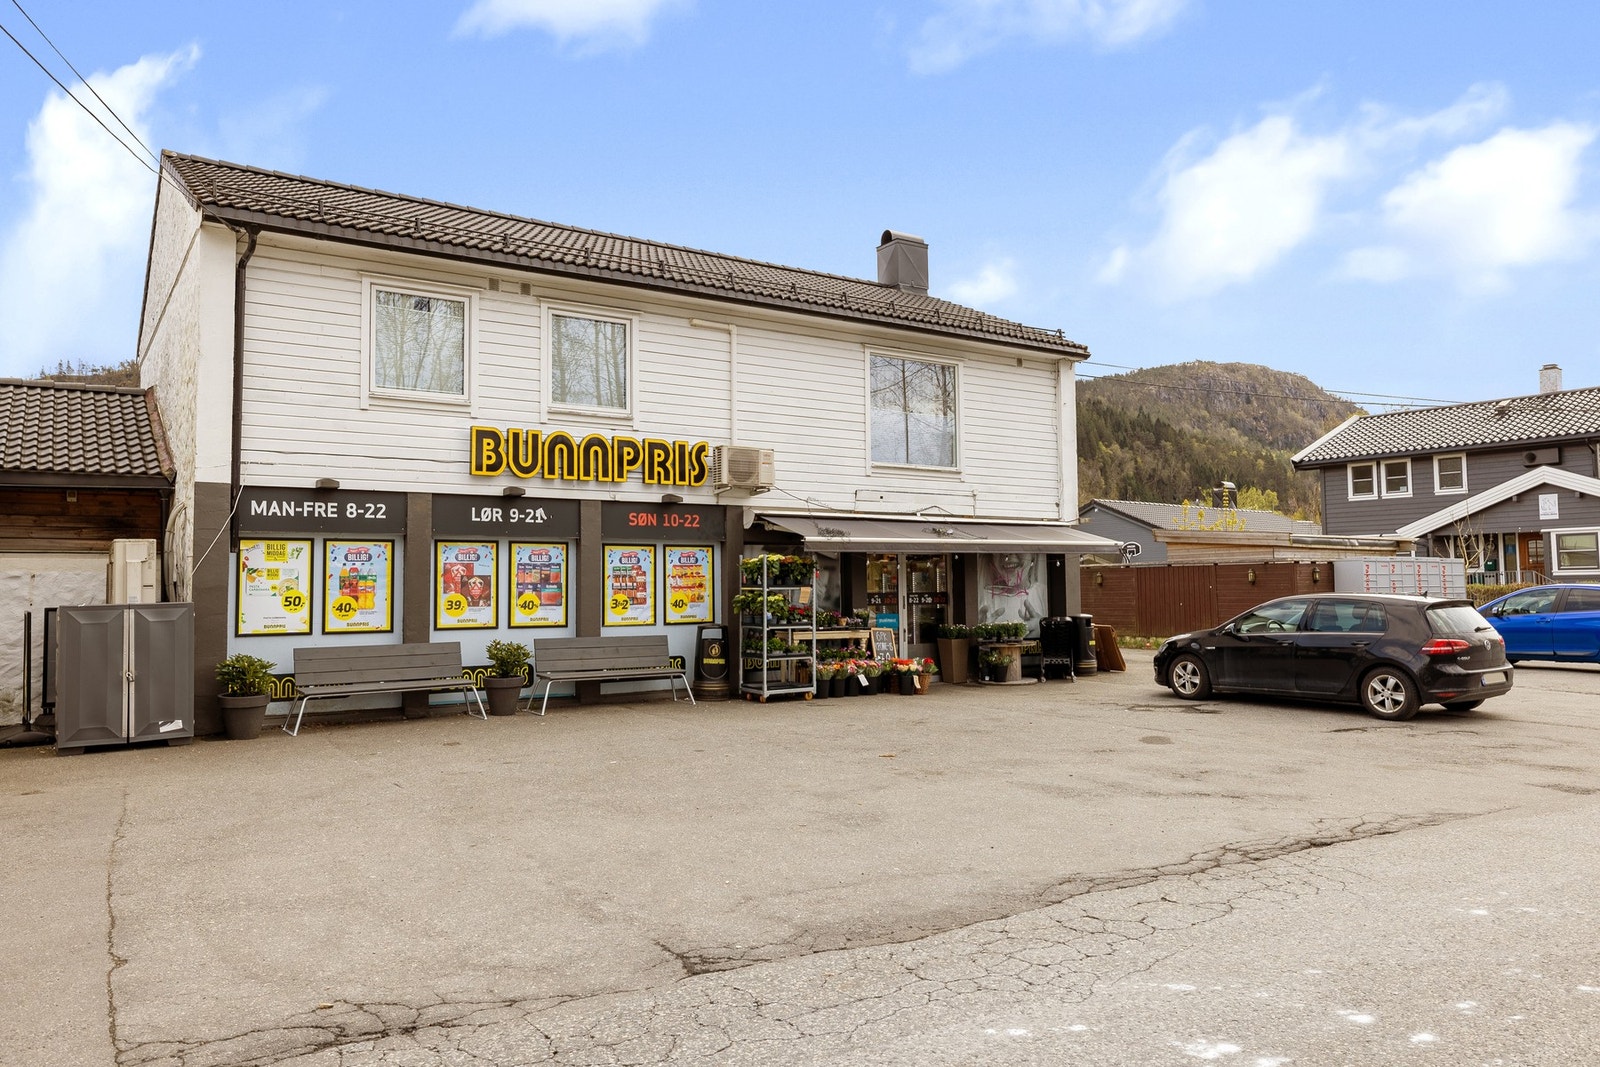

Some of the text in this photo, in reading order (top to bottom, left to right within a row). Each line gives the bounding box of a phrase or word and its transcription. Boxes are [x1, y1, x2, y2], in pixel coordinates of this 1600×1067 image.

[470, 425, 709, 487] BUNNPRIS
[250, 500, 387, 519] MAN-FRE 8-22
[471, 507, 503, 522] LØR
[628, 512, 700, 528] SØN 10-22
[266, 543, 286, 551] BILLIG
[347, 553, 369, 561] BILLIG!
